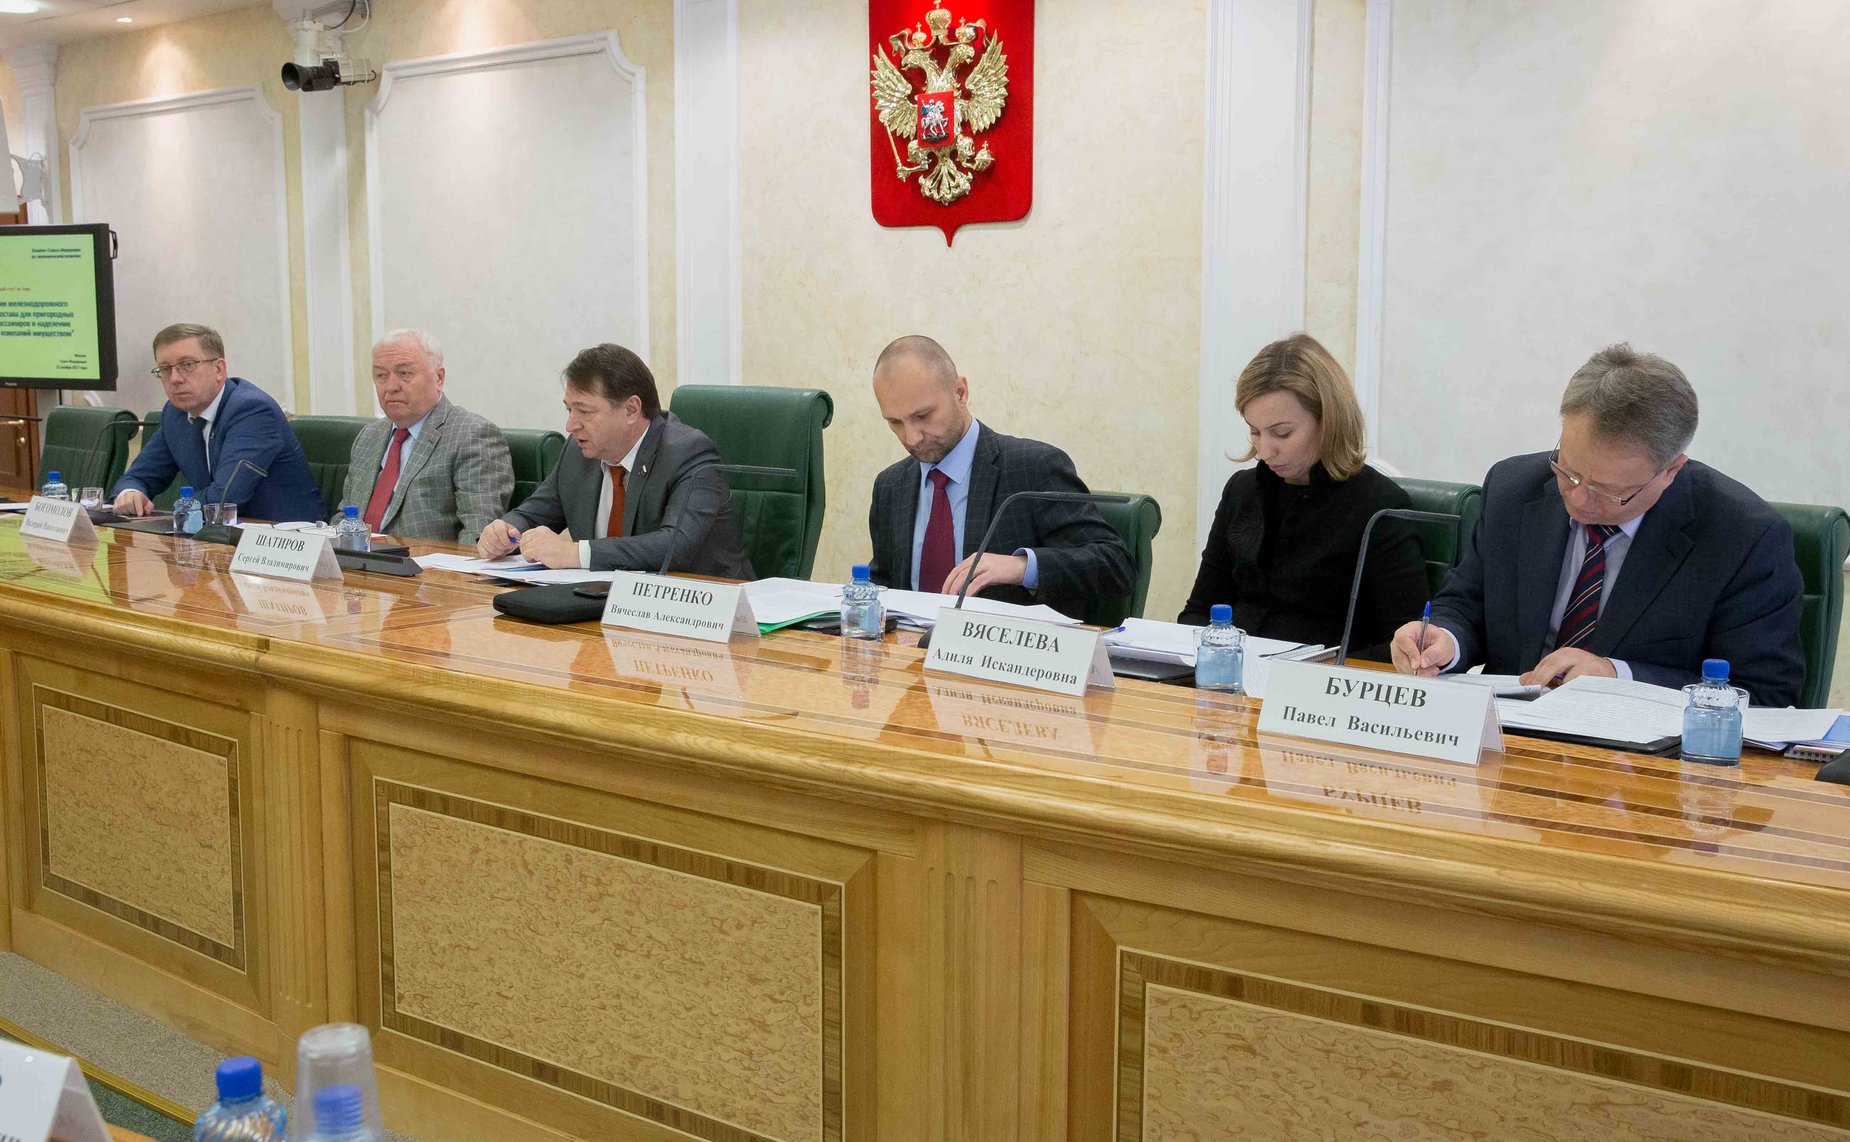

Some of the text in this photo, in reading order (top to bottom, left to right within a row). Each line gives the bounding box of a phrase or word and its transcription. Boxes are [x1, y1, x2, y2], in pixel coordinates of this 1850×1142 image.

[34, 501, 74, 518] БОГОМОЛОВ
[255, 534, 305, 552] ШАТИРОВ
[237, 552, 310, 572] Сергей Владимирович
[632, 582, 713, 606] ПЕТРЕНКО
[610, 604, 651, 619] Вячеслав
[653, 611, 725, 631] Александрович
[962, 621, 1060, 653] ВЯСЕЛЕВА
[932, 648, 1077, 686] Адиля Искандеровна
[1325, 676, 1427, 708] БУРЦЕВ
[1282, 705, 1459, 747] Павел Васильевич
